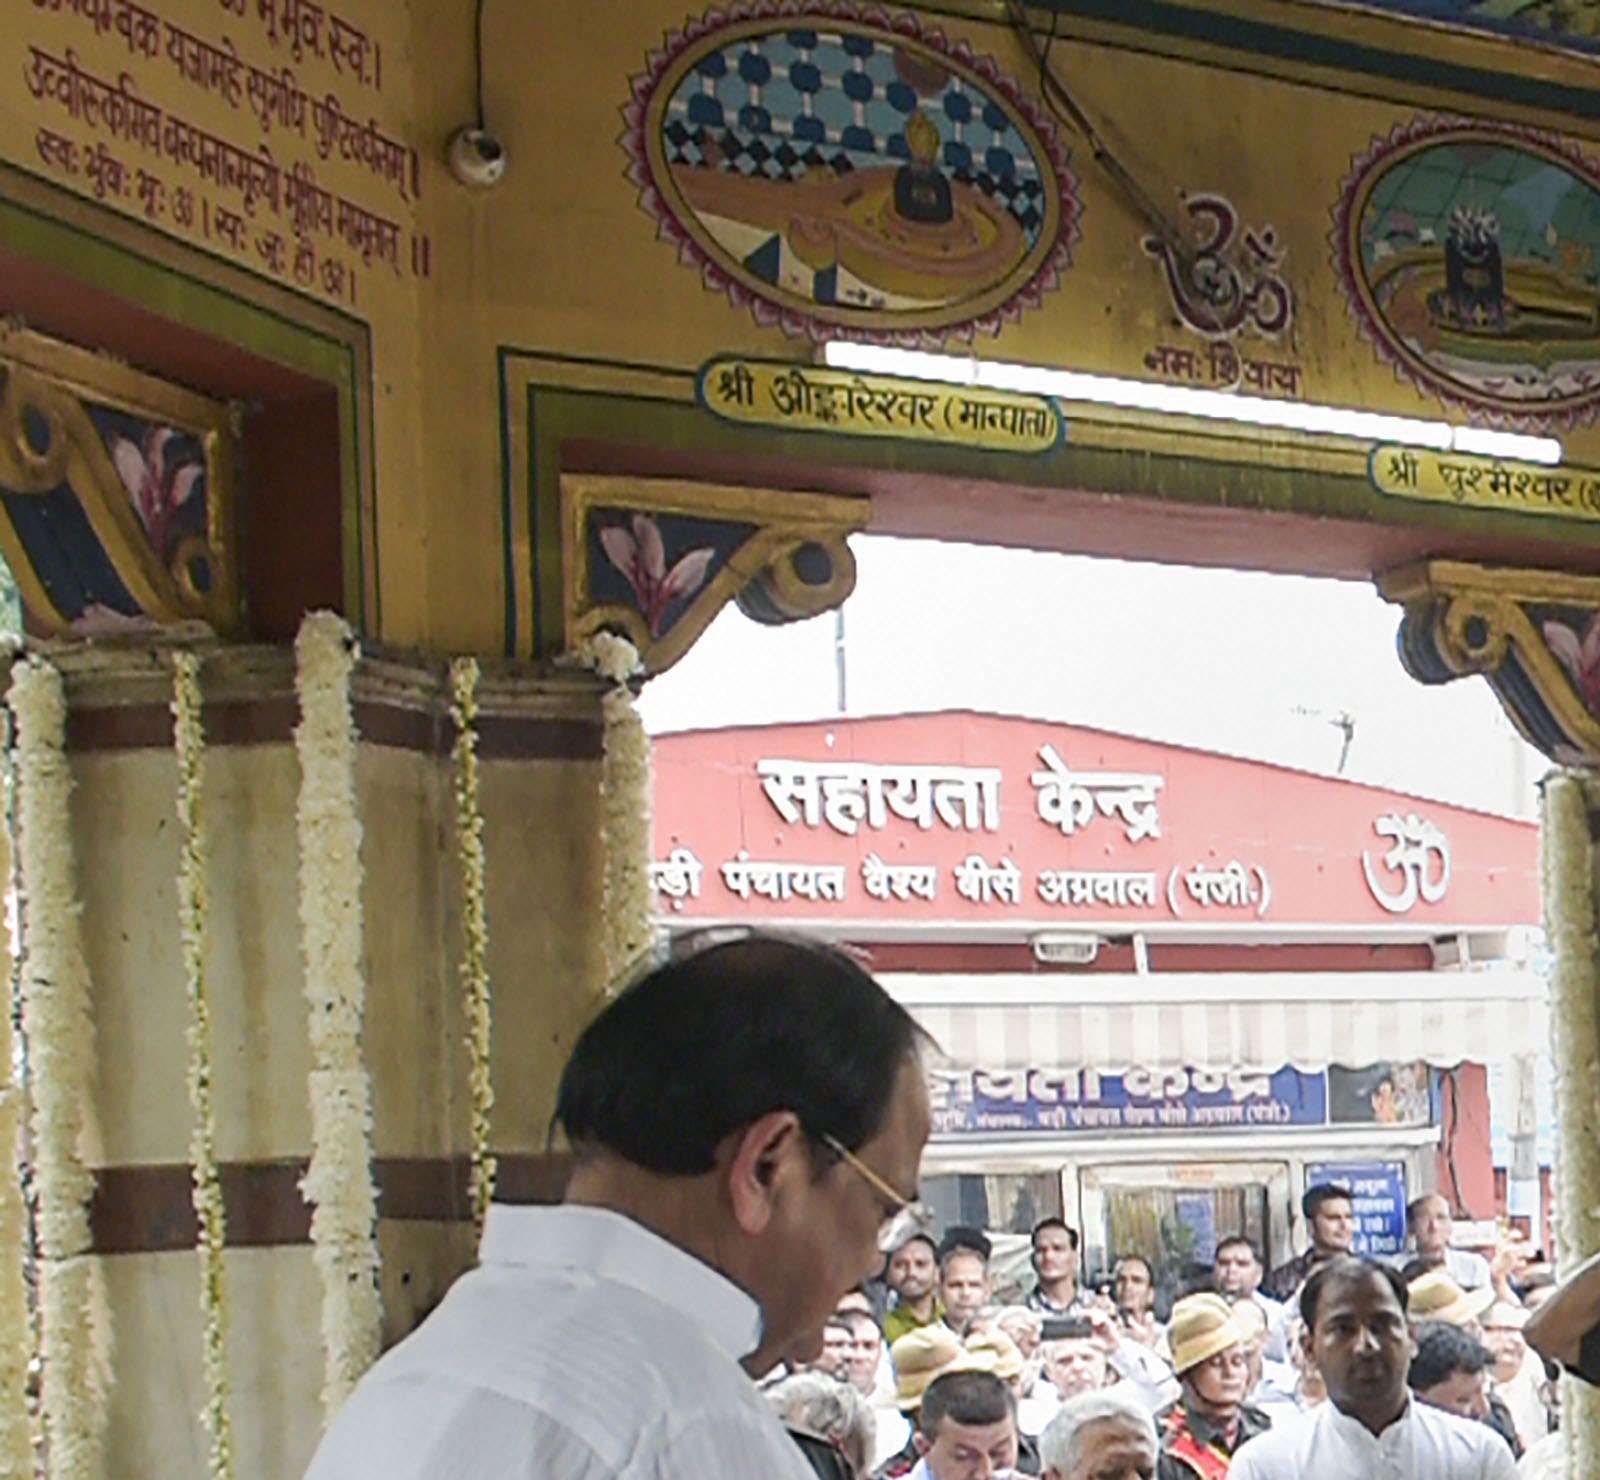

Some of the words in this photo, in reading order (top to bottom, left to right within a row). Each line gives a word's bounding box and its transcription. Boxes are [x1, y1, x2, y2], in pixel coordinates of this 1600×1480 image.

[717, 363, 755, 405] श्री
[1388, 452, 1418, 488] श्री
[756, 757, 1001, 834] सहायता
[1031, 742, 1165, 843] केन्द्र
[648, 848, 703, 913] ड़ी
[719, 849, 846, 902] पंचायत
[862, 850, 937, 901] वैश्य
[955, 856, 1023, 905] बीसे
[1038, 866, 1156, 909] अग्रवाल
